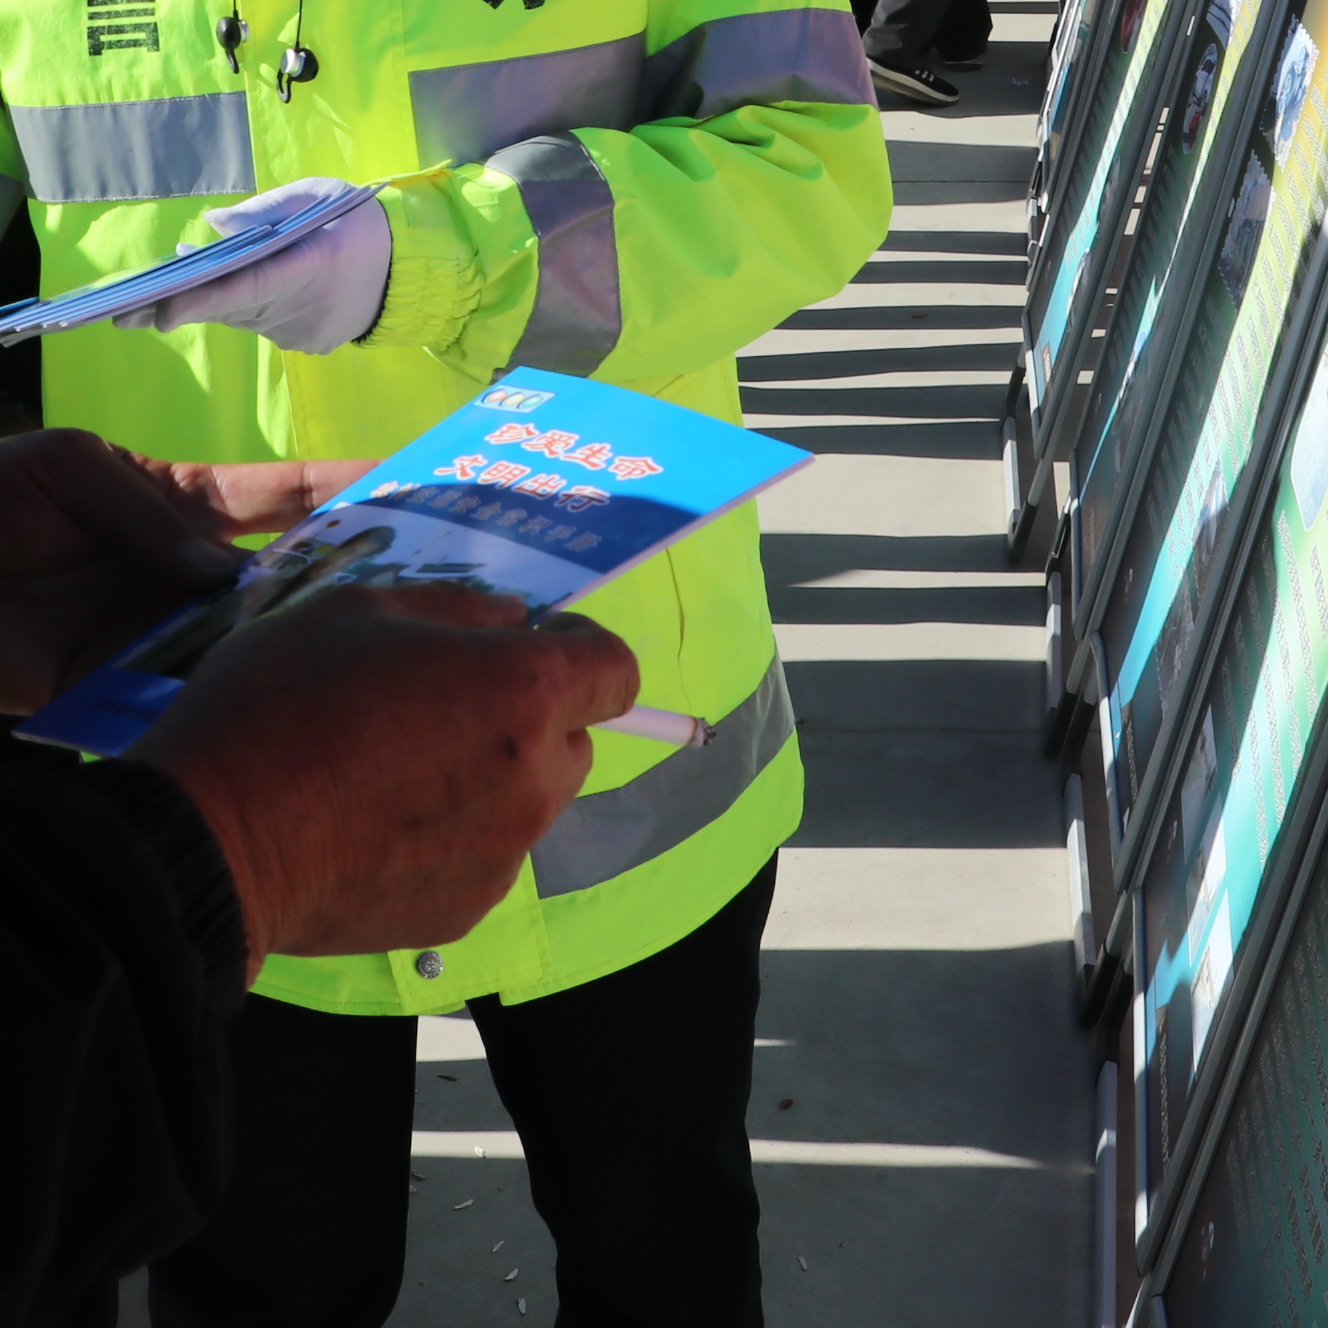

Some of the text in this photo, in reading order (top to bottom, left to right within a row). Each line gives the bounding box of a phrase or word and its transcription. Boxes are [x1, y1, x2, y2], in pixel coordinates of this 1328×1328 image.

[483, 422, 664, 481] 珍爱生命
[433, 453, 611, 512] 文明出行
